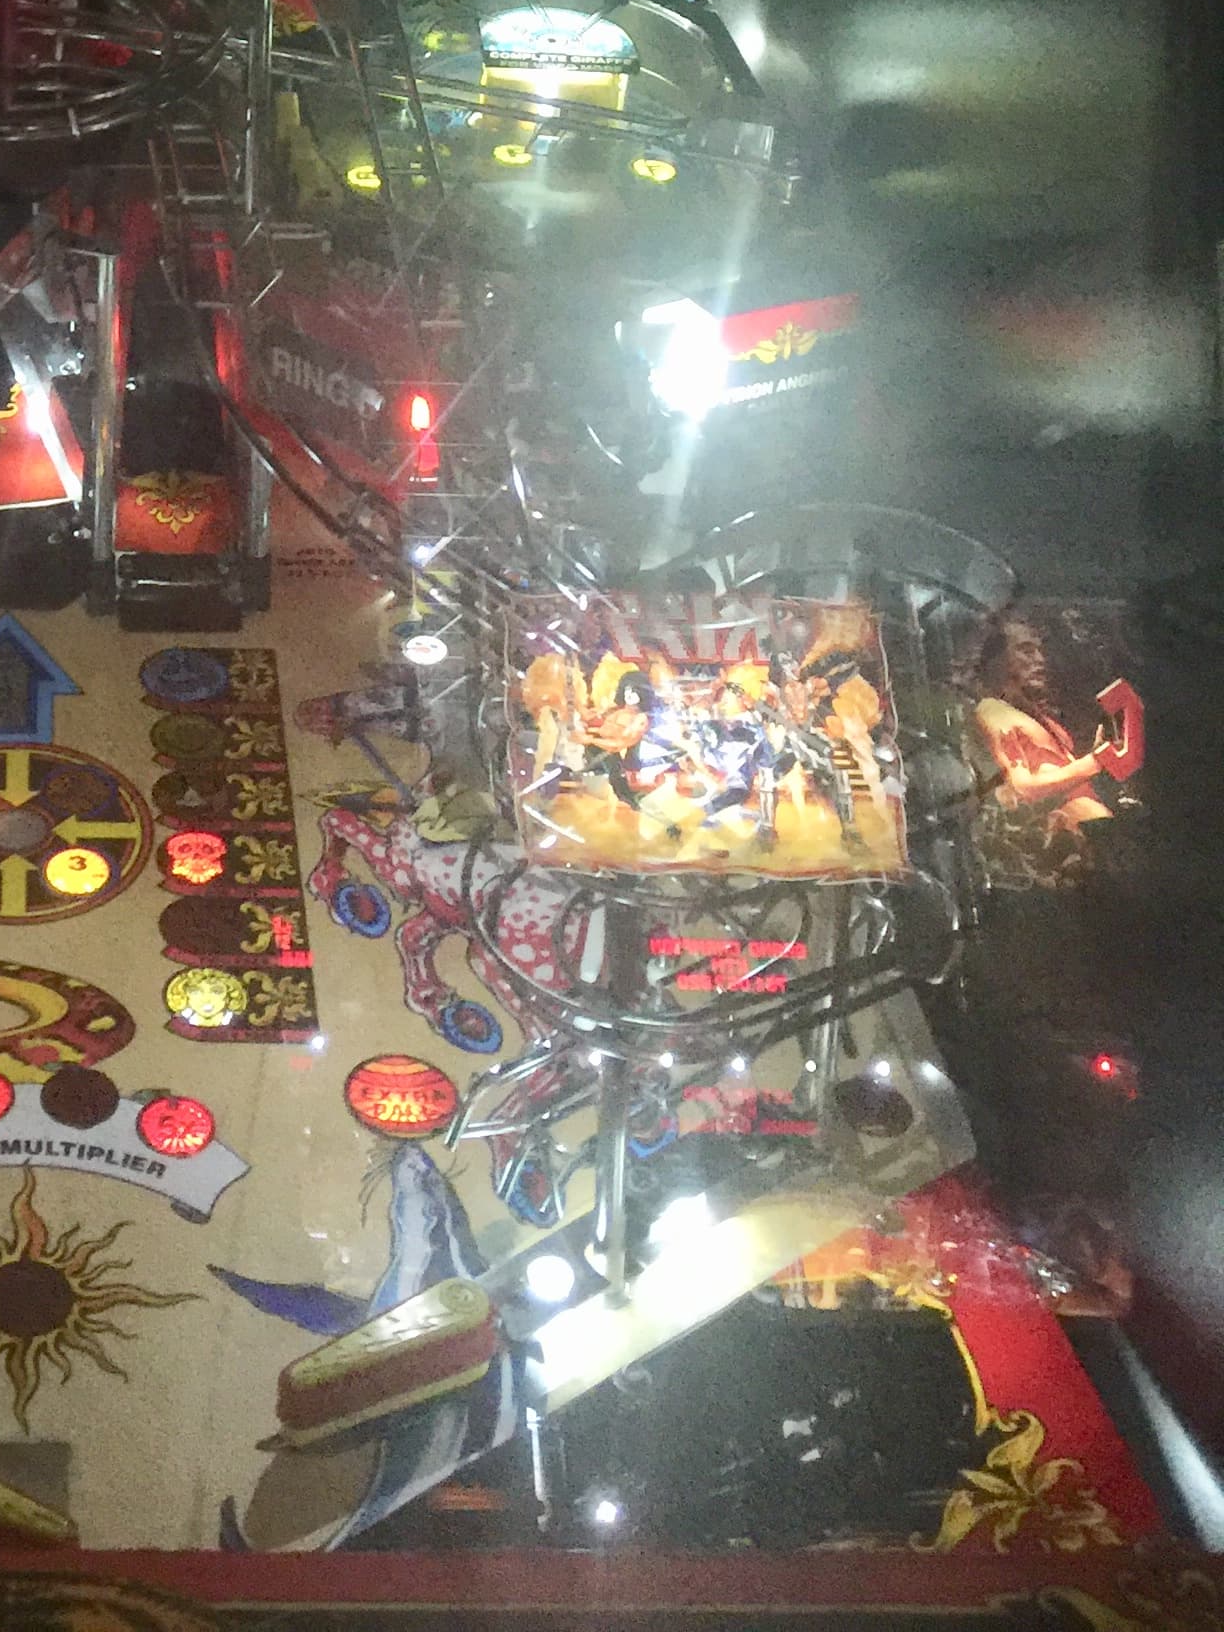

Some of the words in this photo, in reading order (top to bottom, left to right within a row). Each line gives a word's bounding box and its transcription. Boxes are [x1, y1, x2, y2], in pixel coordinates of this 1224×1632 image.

[489, 51, 568, 63] COMPLETE
[570, 55, 633, 66] GIRAFFE
[271, 345, 350, 409] RING
[68, 855, 88, 872] 3
[361, 1087, 447, 1105] EXTRA
[0, 1139, 168, 1178] MULTIPLIER
